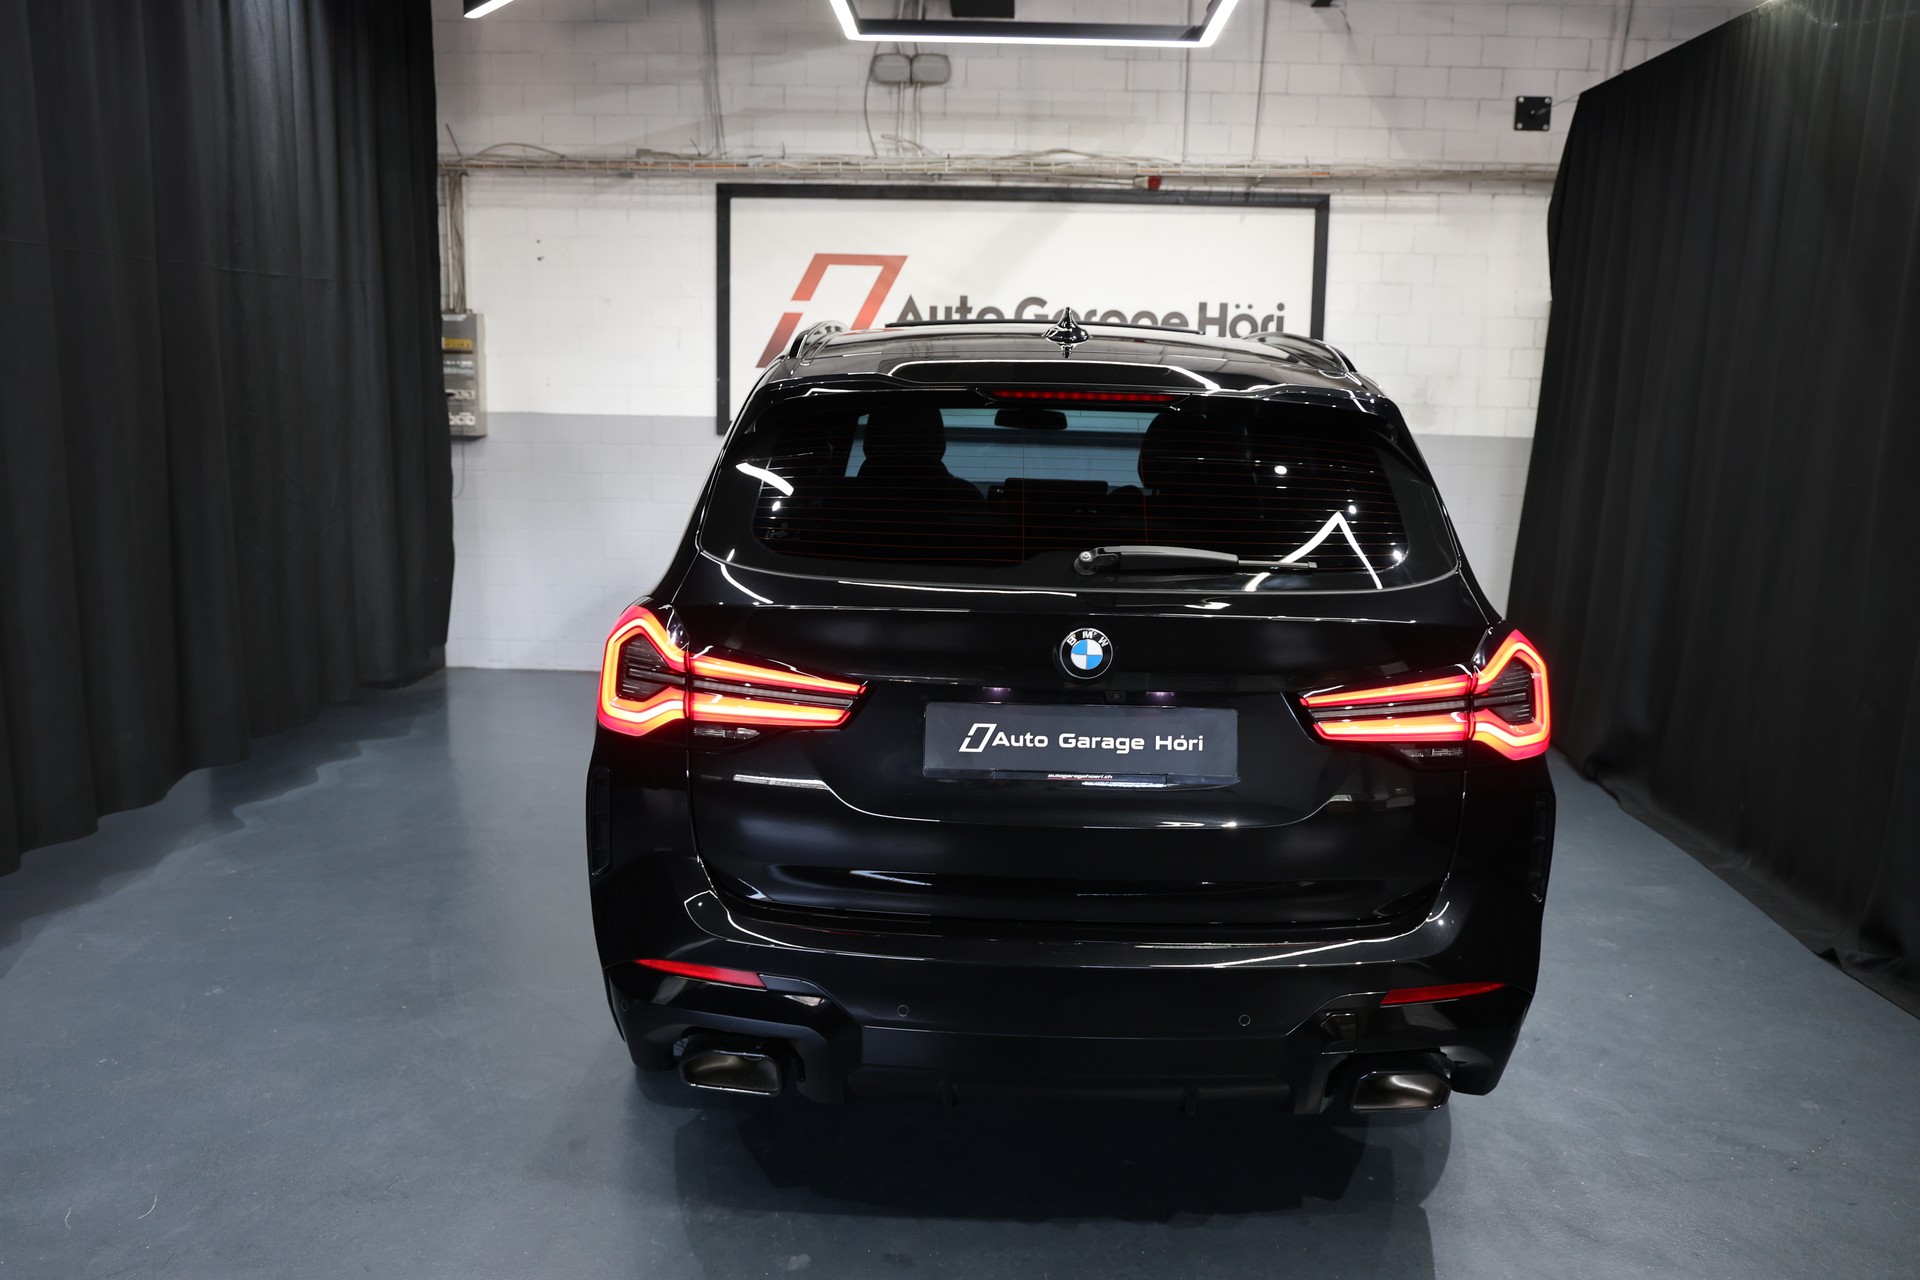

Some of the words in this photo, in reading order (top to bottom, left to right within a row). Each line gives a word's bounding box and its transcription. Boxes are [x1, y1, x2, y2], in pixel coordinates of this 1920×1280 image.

[897, 294, 1005, 322] Auto
[1199, 302, 1285, 339] Höri
[1066, 630, 1109, 647] BMW
[991, 731, 1049, 748] Auto
[1058, 733, 1145, 754] Garage
